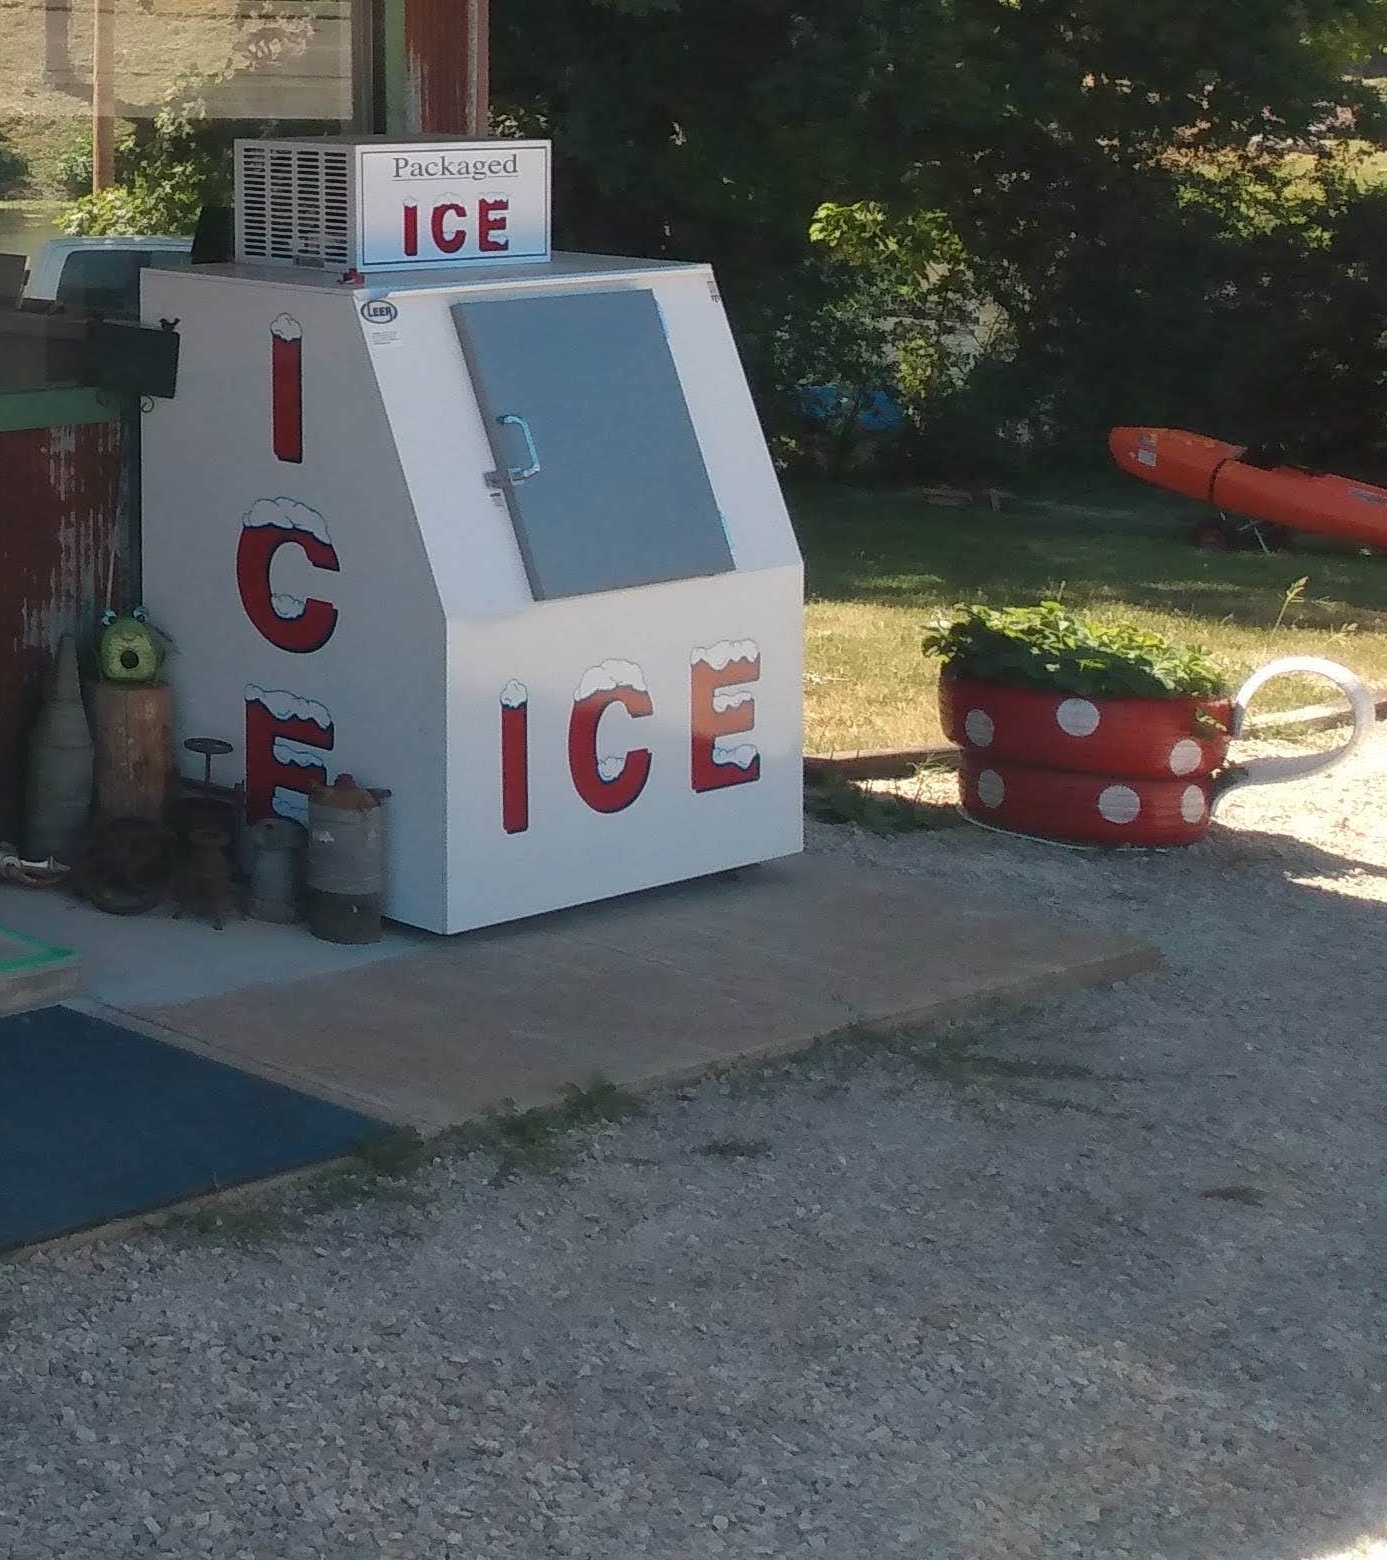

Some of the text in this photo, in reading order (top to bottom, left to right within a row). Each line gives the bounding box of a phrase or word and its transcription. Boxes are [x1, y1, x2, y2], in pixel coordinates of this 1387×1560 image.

[392, 153, 520, 182] Packaged
[401, 194, 510, 257] ICE
[367, 302, 393, 320] LEER
[236, 312, 341, 826] ICE
[500, 638, 762, 835] ICE
